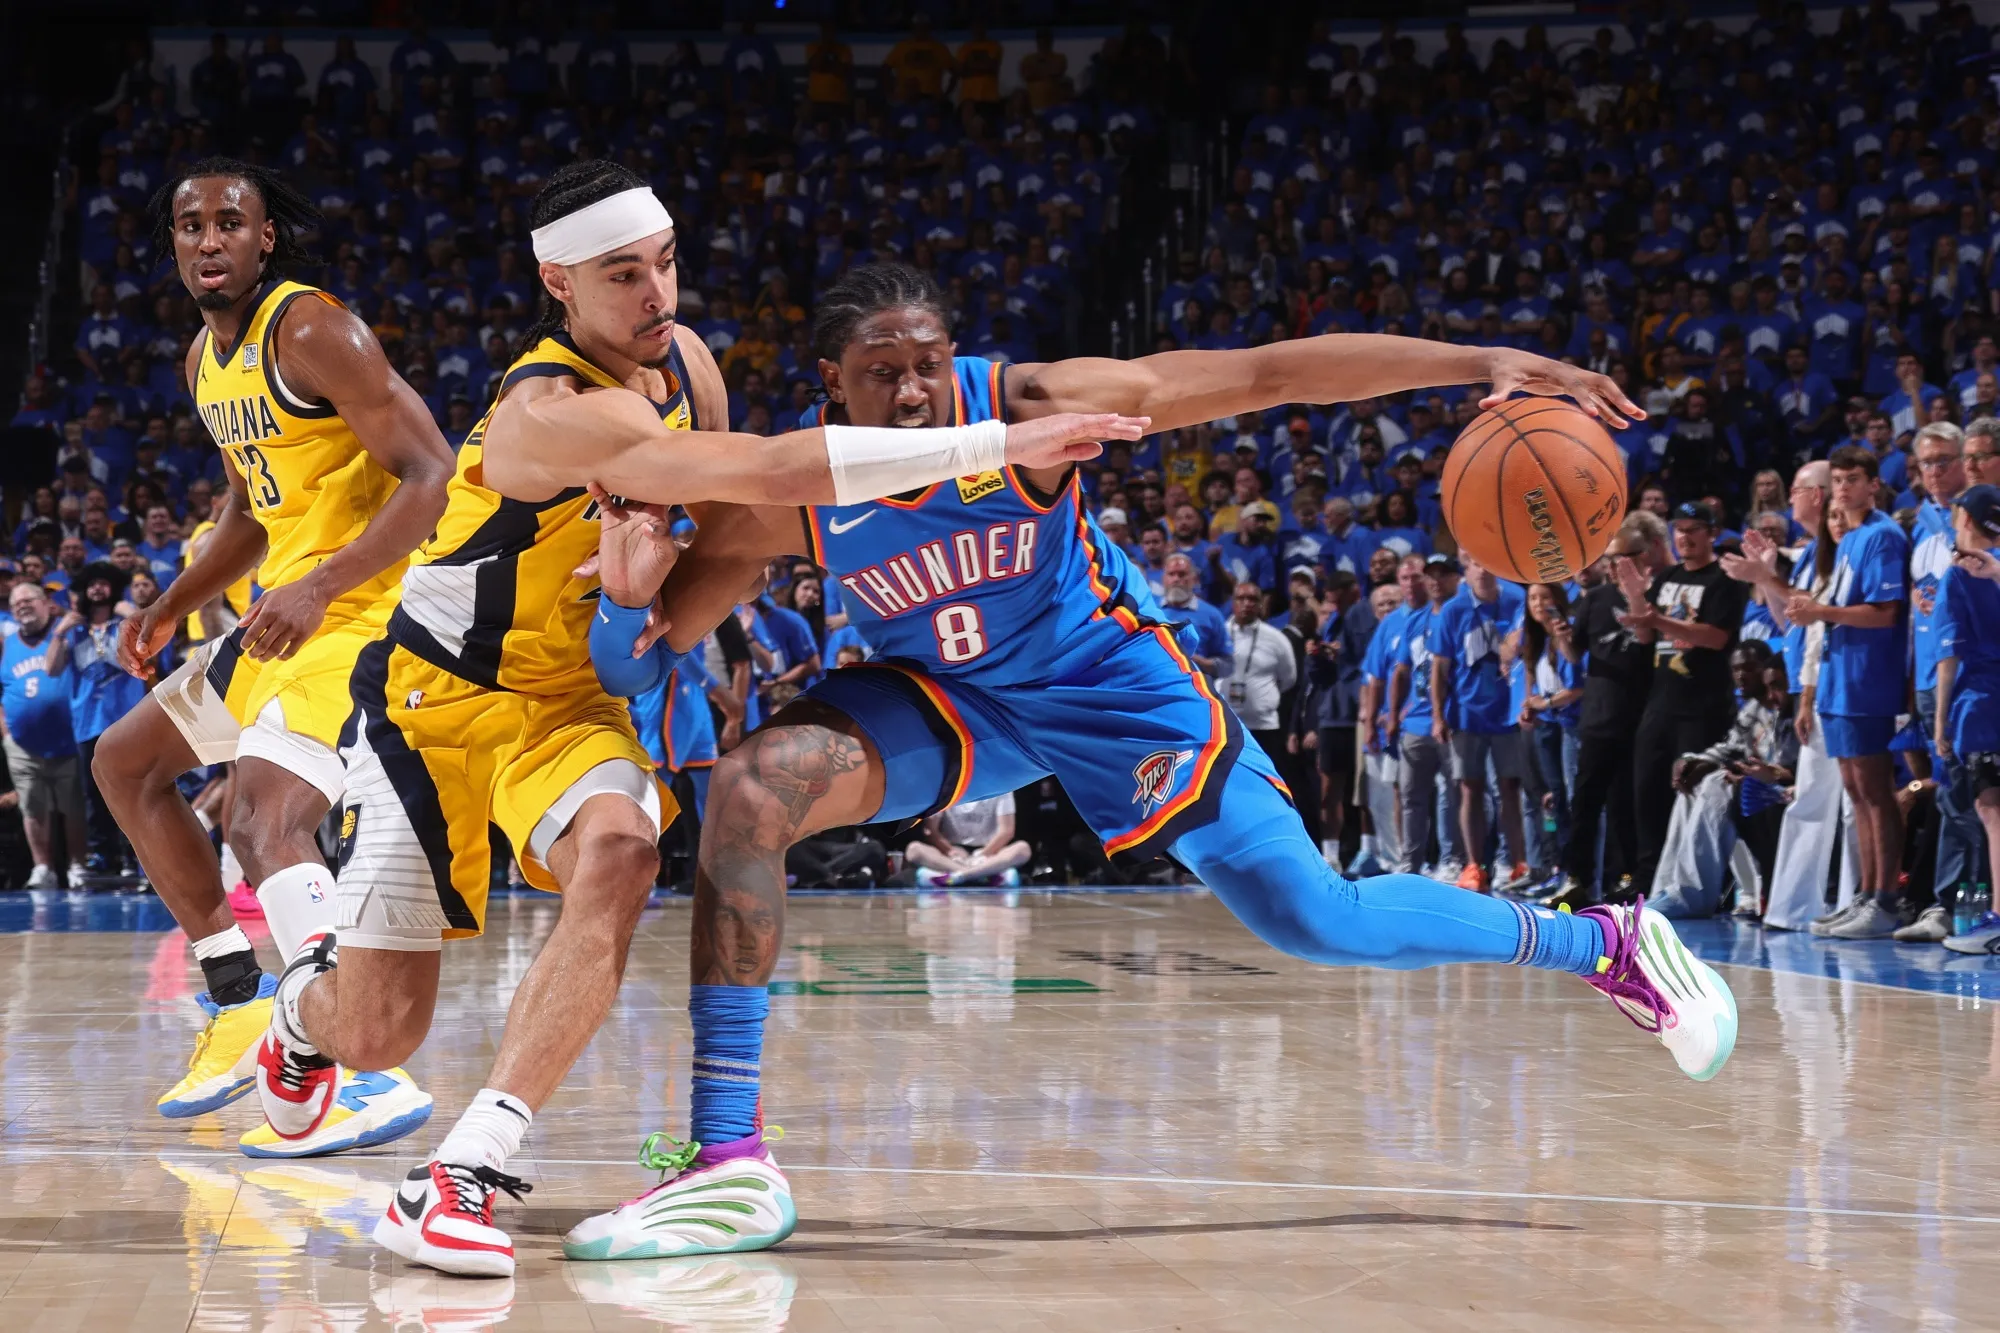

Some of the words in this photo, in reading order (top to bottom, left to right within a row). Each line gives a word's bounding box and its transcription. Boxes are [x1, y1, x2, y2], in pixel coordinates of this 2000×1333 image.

[840, 518, 1039, 620] THUNDER
[1523, 485, 1571, 582] Wilson
[931, 602, 988, 664] 8
[1142, 758, 1167, 803] OKC
